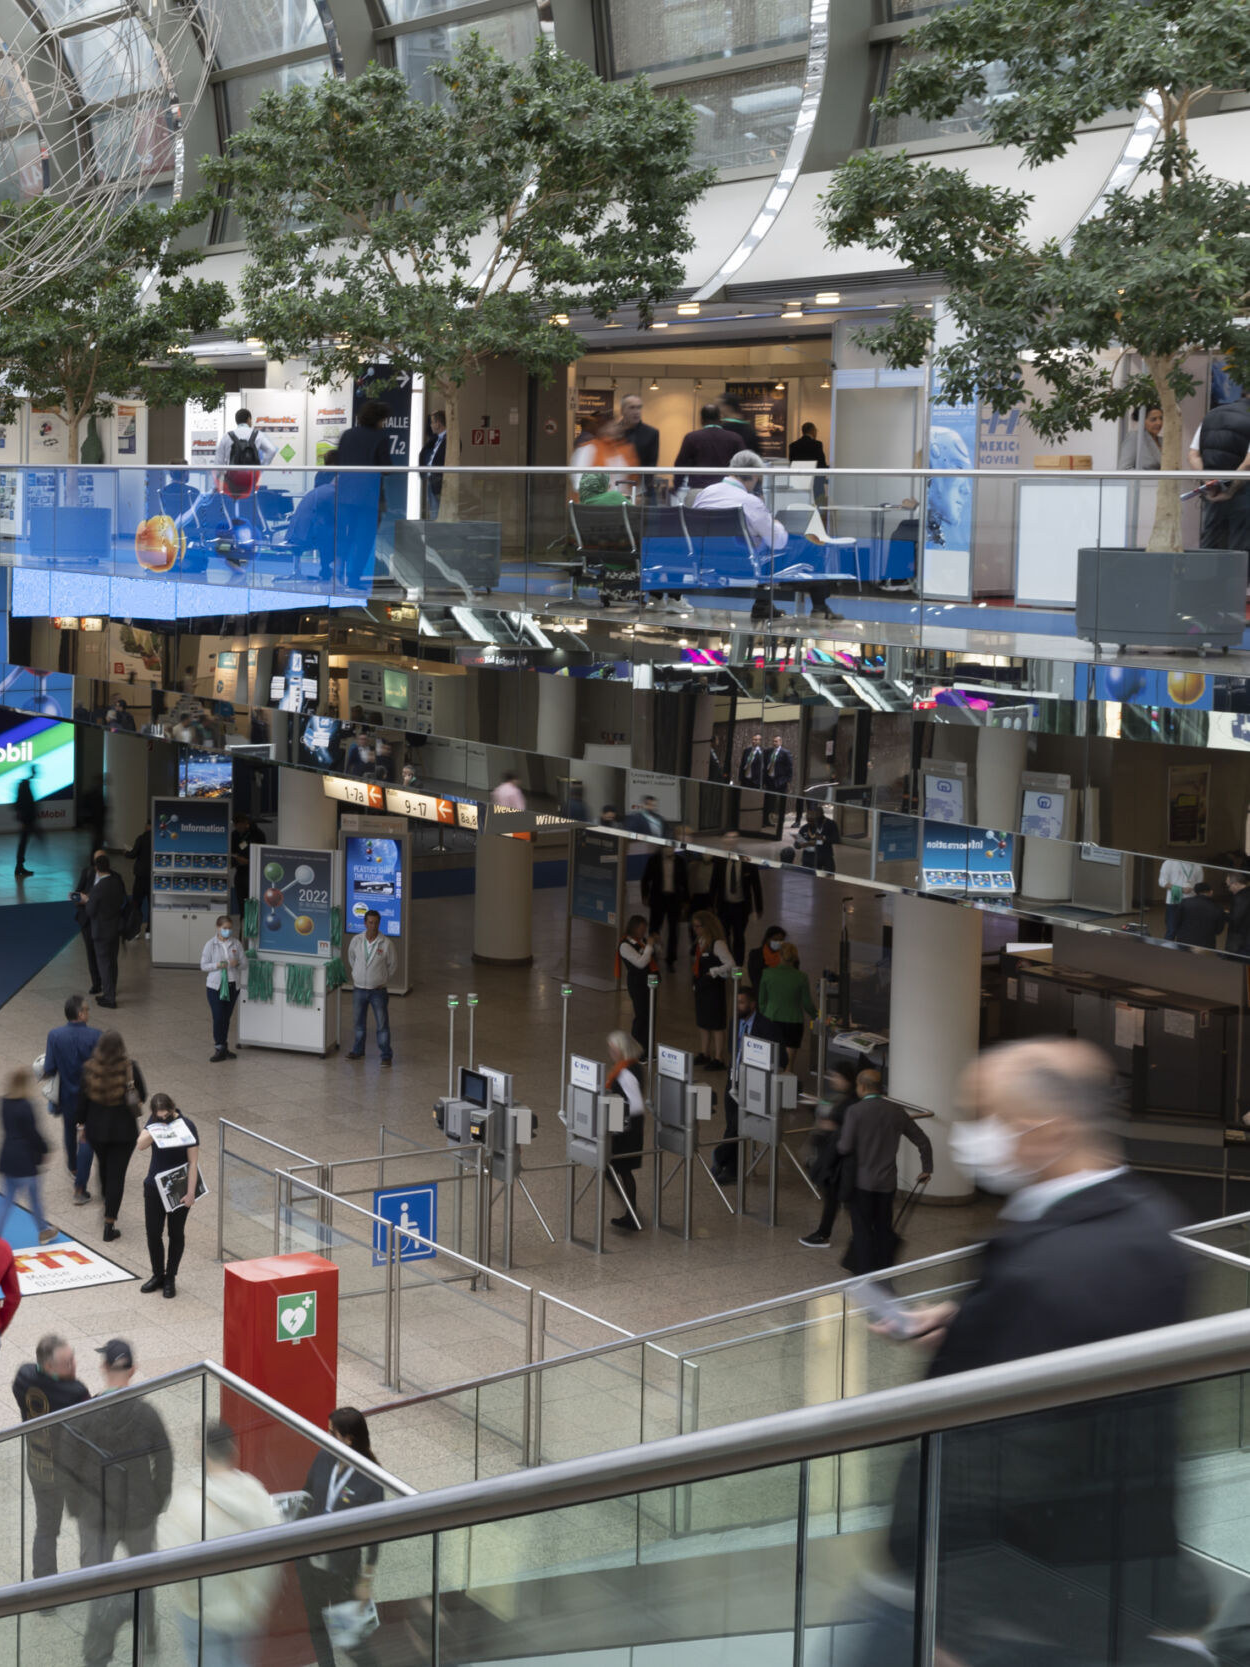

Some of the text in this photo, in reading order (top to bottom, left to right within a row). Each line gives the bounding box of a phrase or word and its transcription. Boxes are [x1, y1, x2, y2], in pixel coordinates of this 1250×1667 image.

[389, 434, 406, 455] 7.2
[180, 823, 226, 834] Information
[298, 888, 328, 904] 2022
